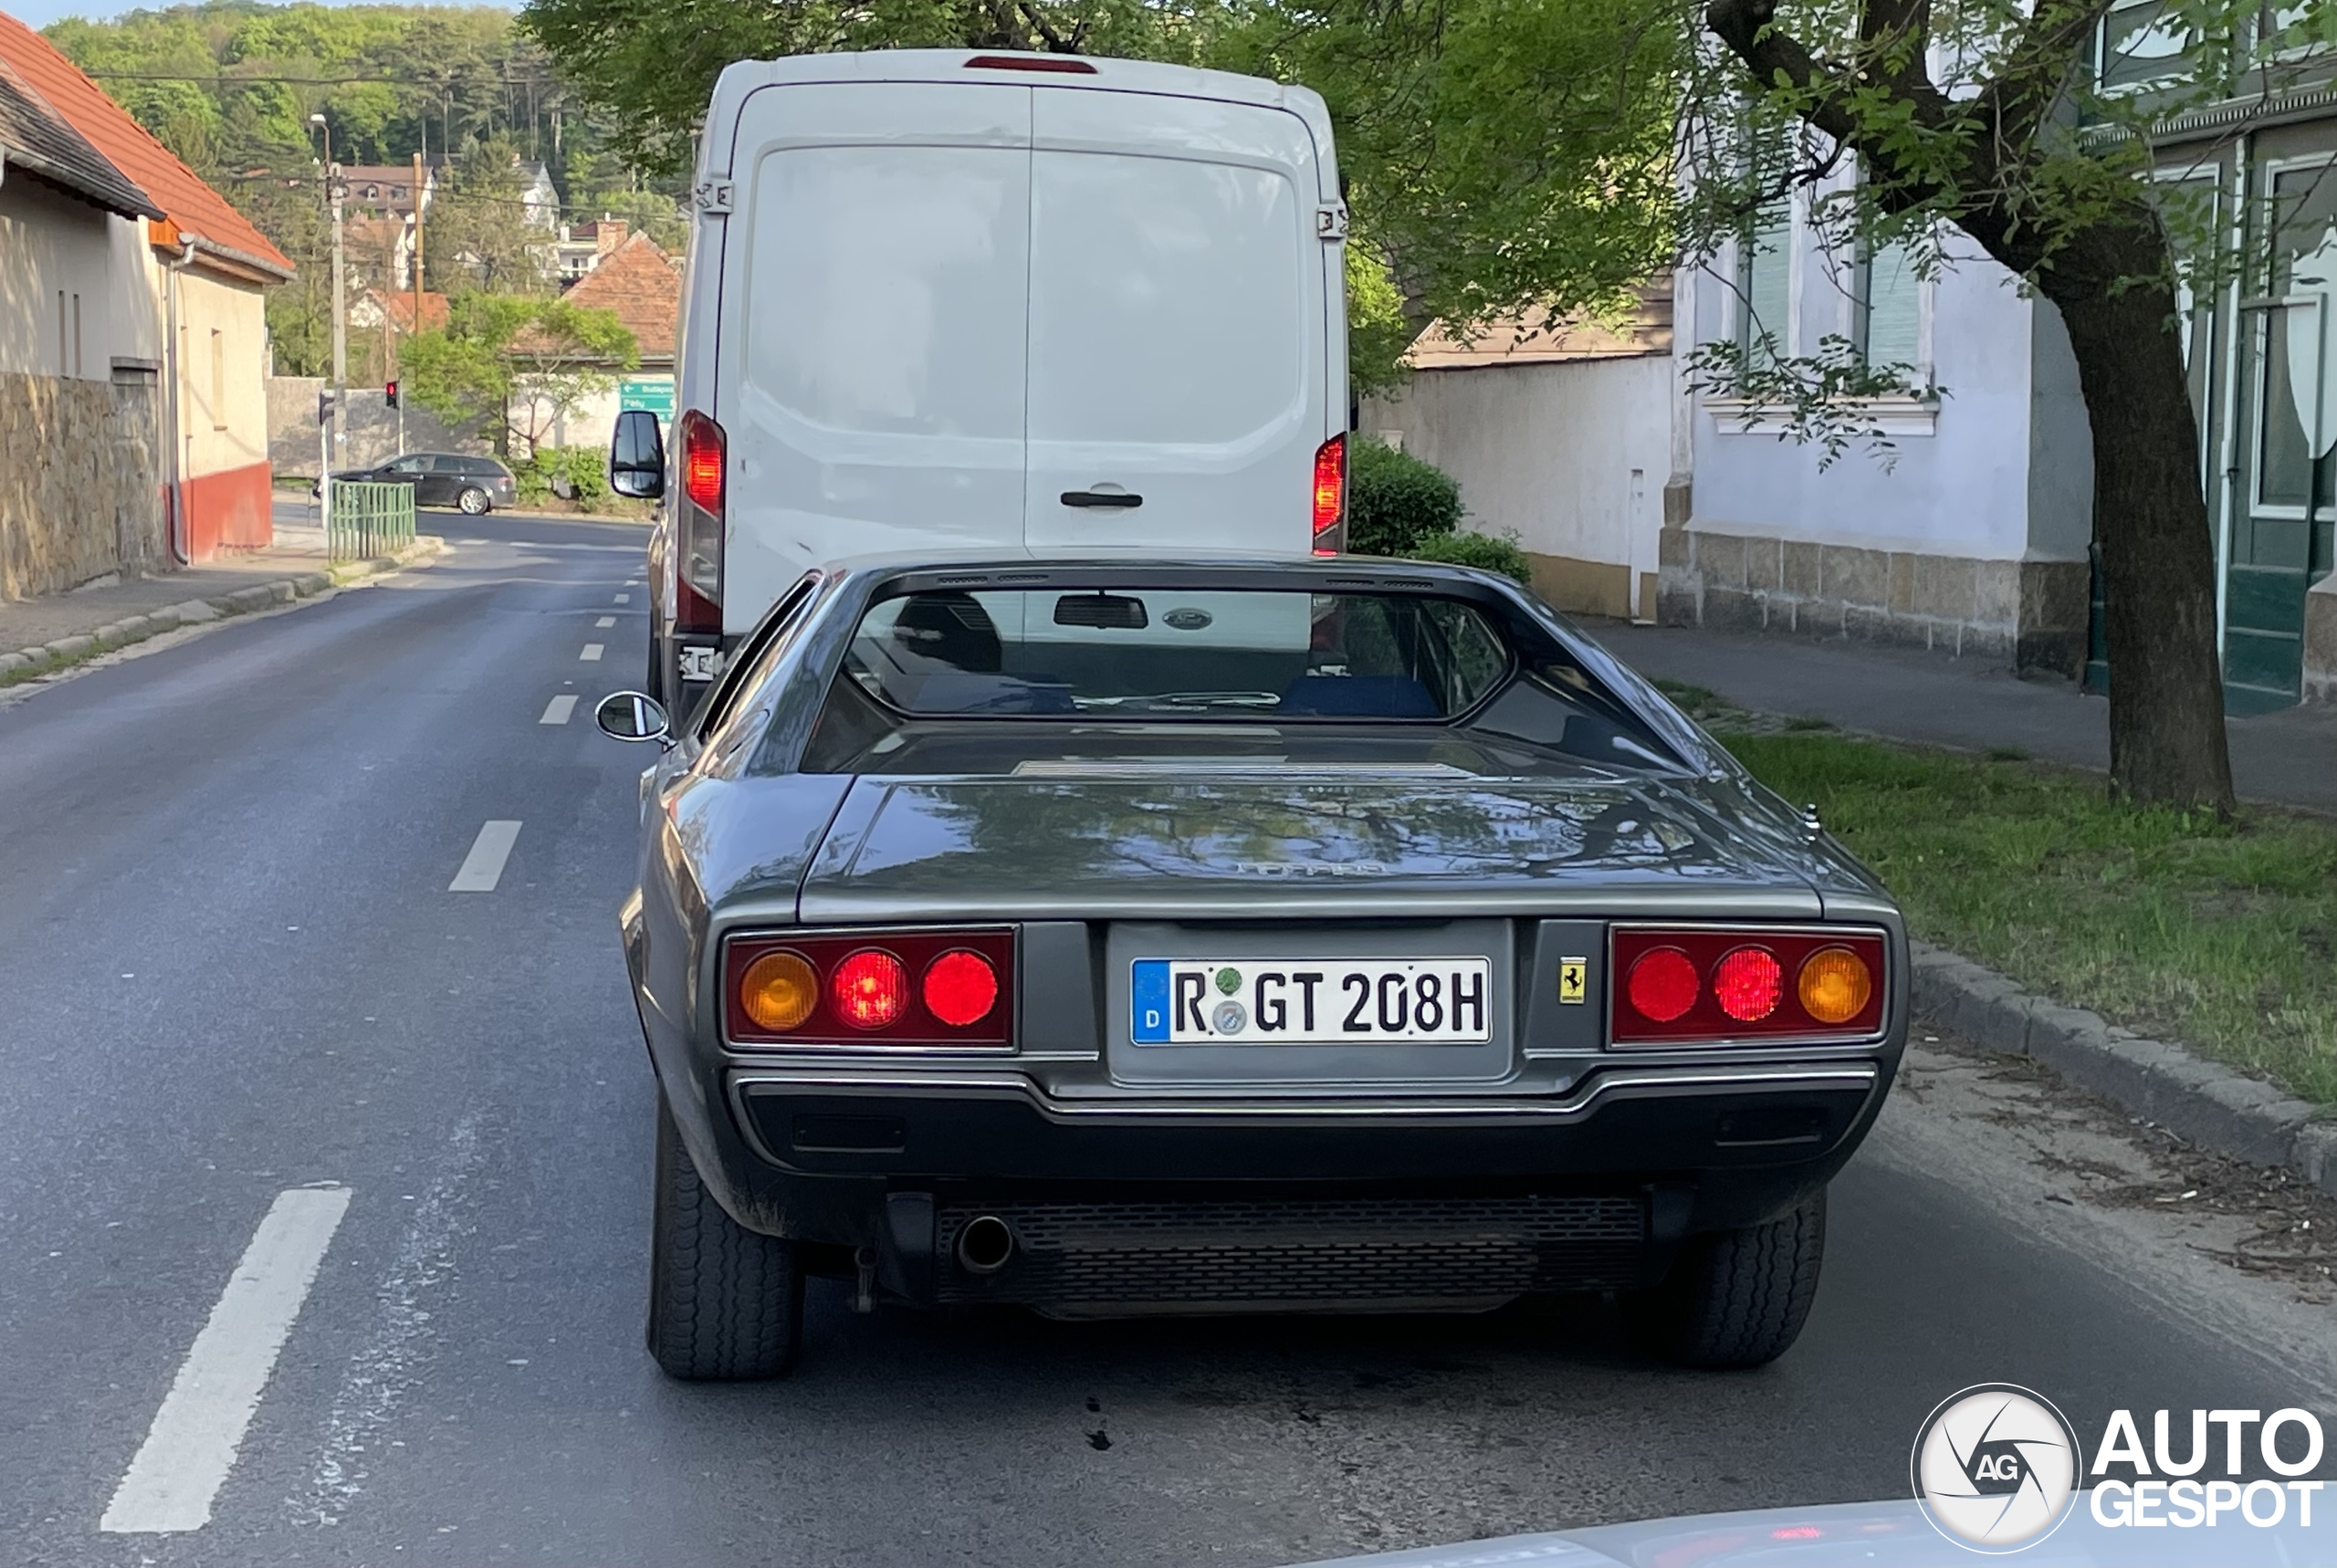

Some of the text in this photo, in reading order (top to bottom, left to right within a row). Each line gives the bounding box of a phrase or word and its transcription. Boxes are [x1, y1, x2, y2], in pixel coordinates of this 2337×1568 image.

[1145, 1009, 1160, 1029] D
[1175, 972, 1483, 1032] R GT 208H
